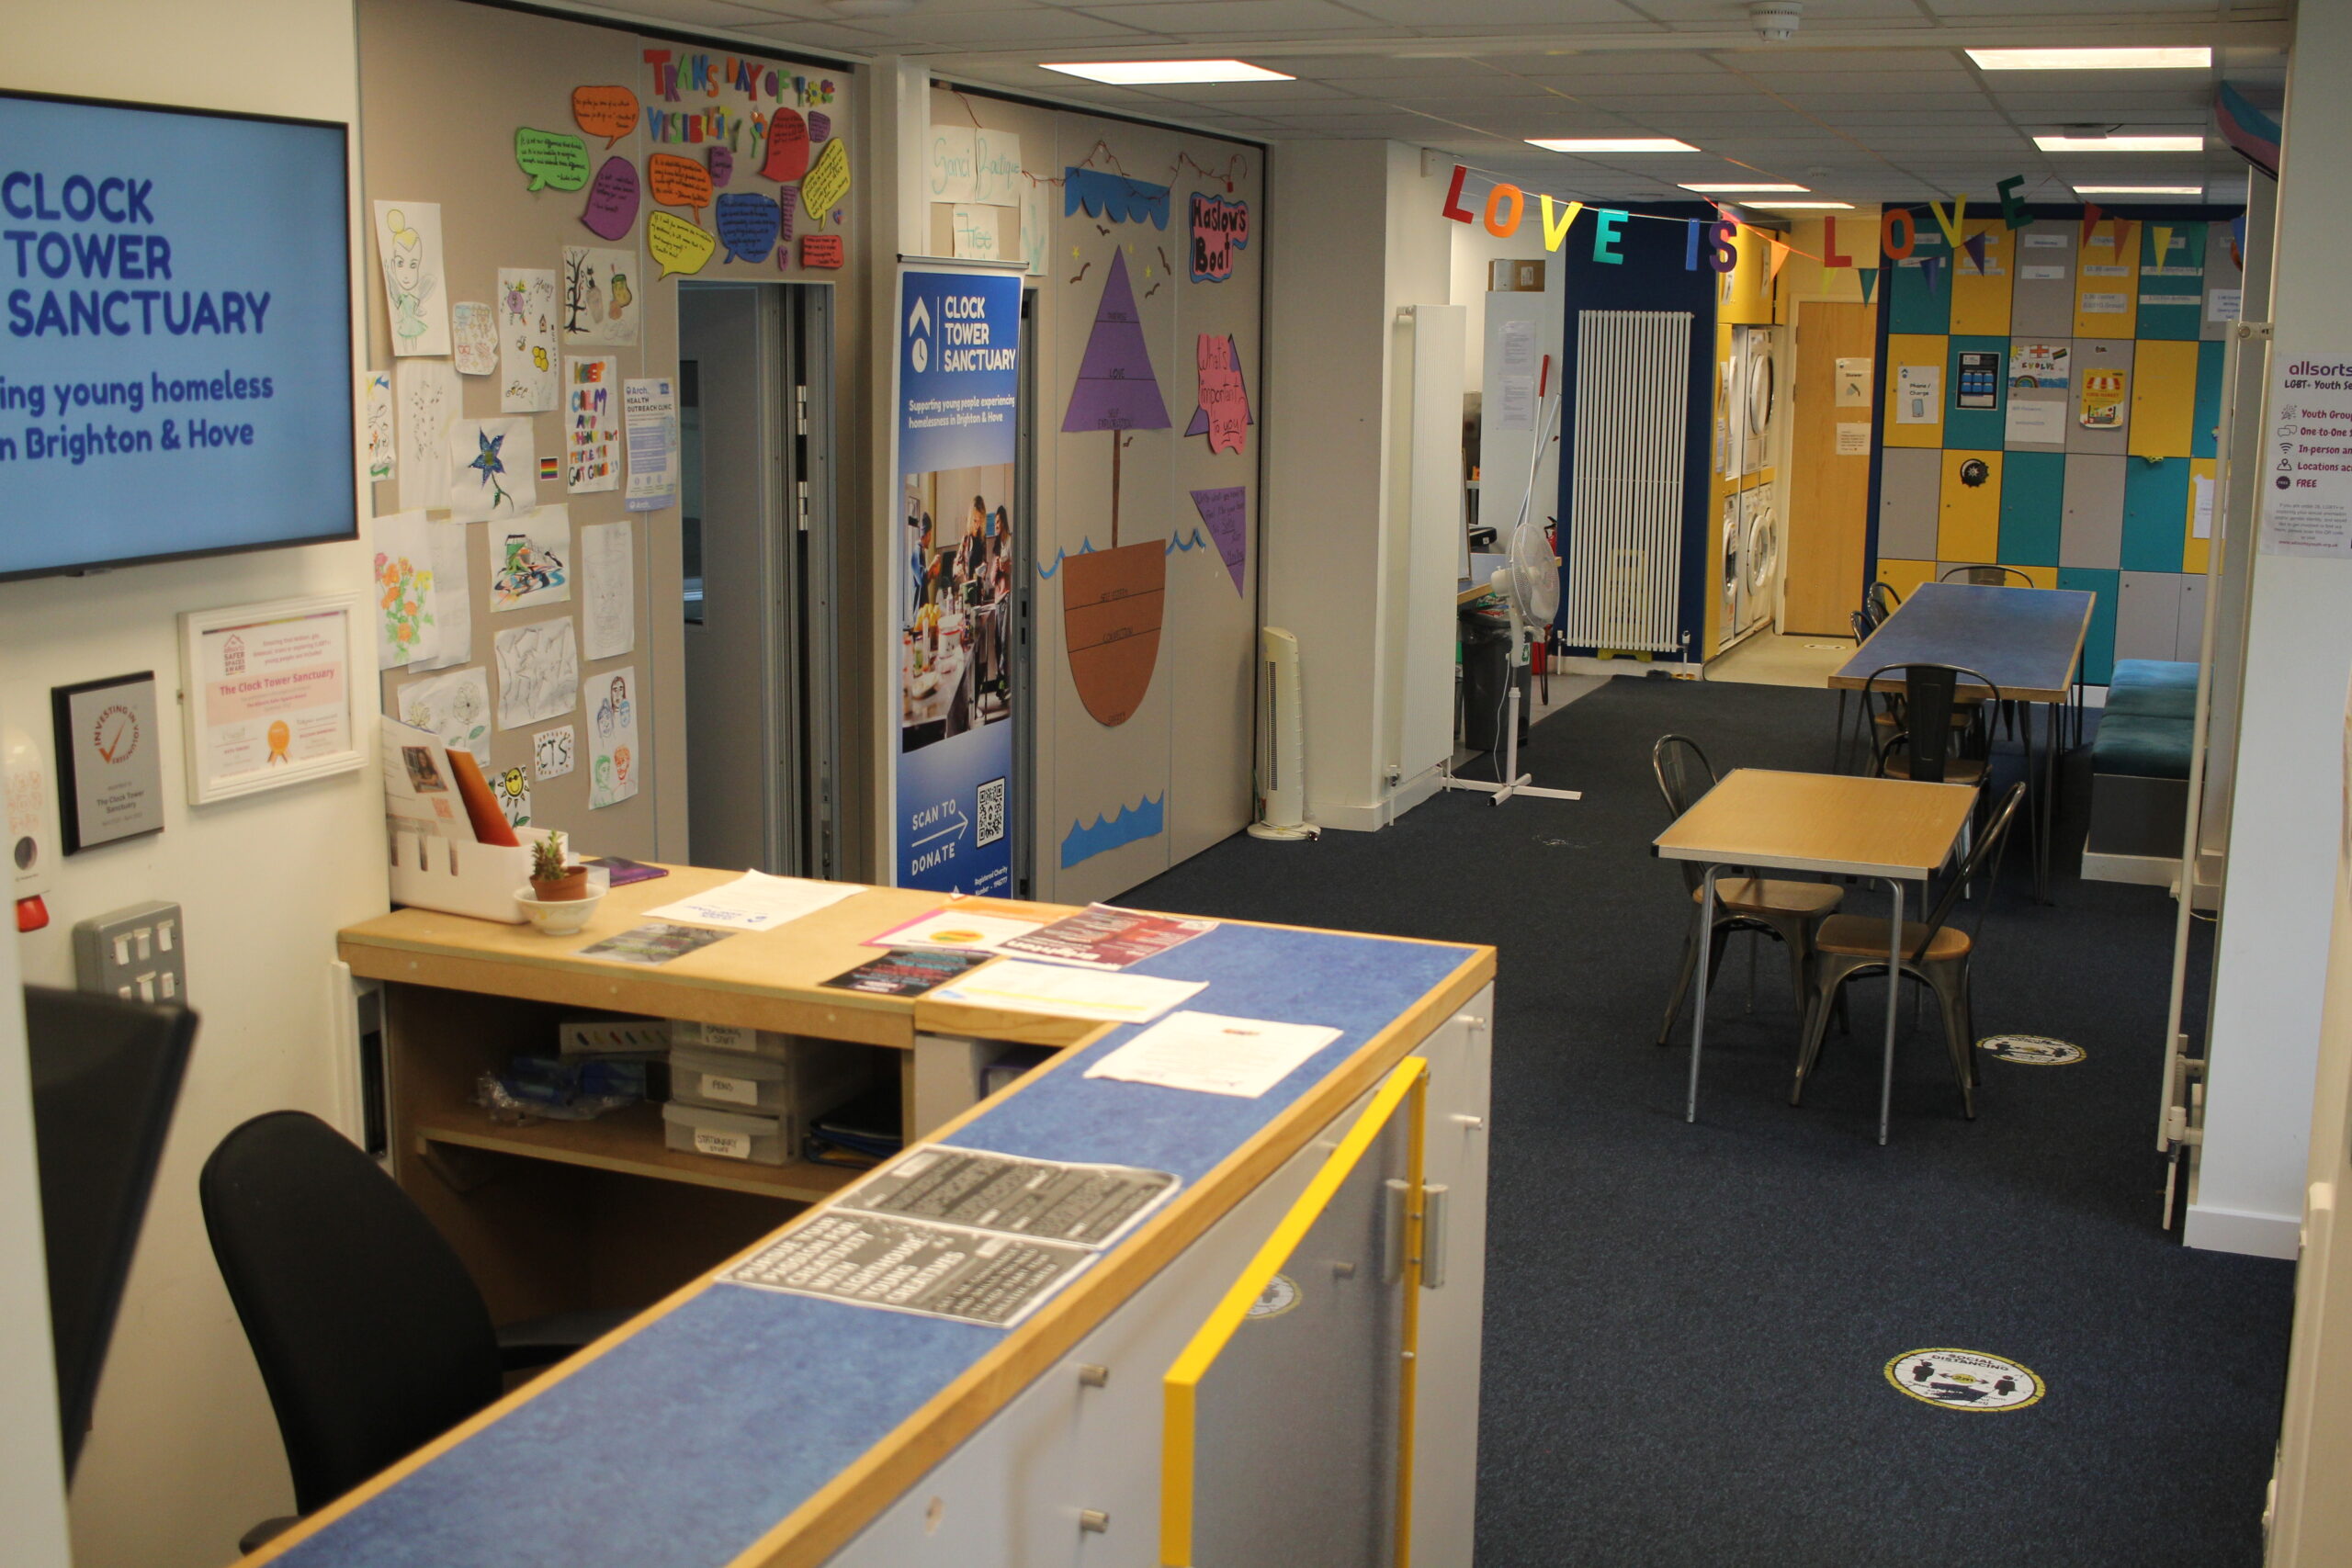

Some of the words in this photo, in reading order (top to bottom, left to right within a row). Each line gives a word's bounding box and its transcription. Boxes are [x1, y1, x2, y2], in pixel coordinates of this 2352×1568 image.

[644, 49, 719, 102] TRANS
[1, 170, 154, 225] CLOCK
[956, 212, 992, 250] Free
[1442, 164, 1629, 265] LOVE
[1685, 217, 1737, 274] IS
[1824, 174, 2035, 268] LOVE
[3, 230, 173, 280] TOWER
[1195, 232, 1230, 273] Boat
[7, 288, 272, 337] SANCTUARY
[944, 296, 986, 320] CLOCK
[944, 322, 989, 345] TOWER
[944, 348, 1016, 372] SANCTUARY
[54, 379, 144, 416] young
[152, 369, 275, 404] homeless
[2314, 379, 2341, 390] Youth
[909, 398, 942, 414] Supporting
[943, 399, 961, 412] young
[961, 396, 979, 412] people
[981, 393, 1015, 410] experiencing
[2301, 408, 2327, 419] Youth
[909, 416, 950, 429] homelessness
[950, 415, 956, 426] in
[956, 413, 980, 428] Brighton
[981, 412, 987, 423] &
[988, 412, 1003, 423] Hove
[26, 423, 153, 466] Brighton
[161, 419, 180, 451] &
[188, 418, 254, 449] Hove
[2297, 461, 2339, 471] Locations
[2296, 478, 2318, 488] FREE
[220, 684, 236, 696] The
[238, 680, 263, 694] Clock
[264, 674, 291, 689] Tower
[292, 668, 336, 683] Sanctuary
[94, 704, 129, 747] INVESTING
[911, 805, 939, 831] SCAN
[942, 798, 956, 818] TO
[911, 841, 956, 876] DONATE
[974, 870, 994, 887] Registered
[993, 865, 1008, 877] Charity
[861, 1264, 920, 1297] YOUNG
[1930, 1354, 2010, 1372] DISTANCING
[1948, 1353, 1994, 1365] SOCIAL
